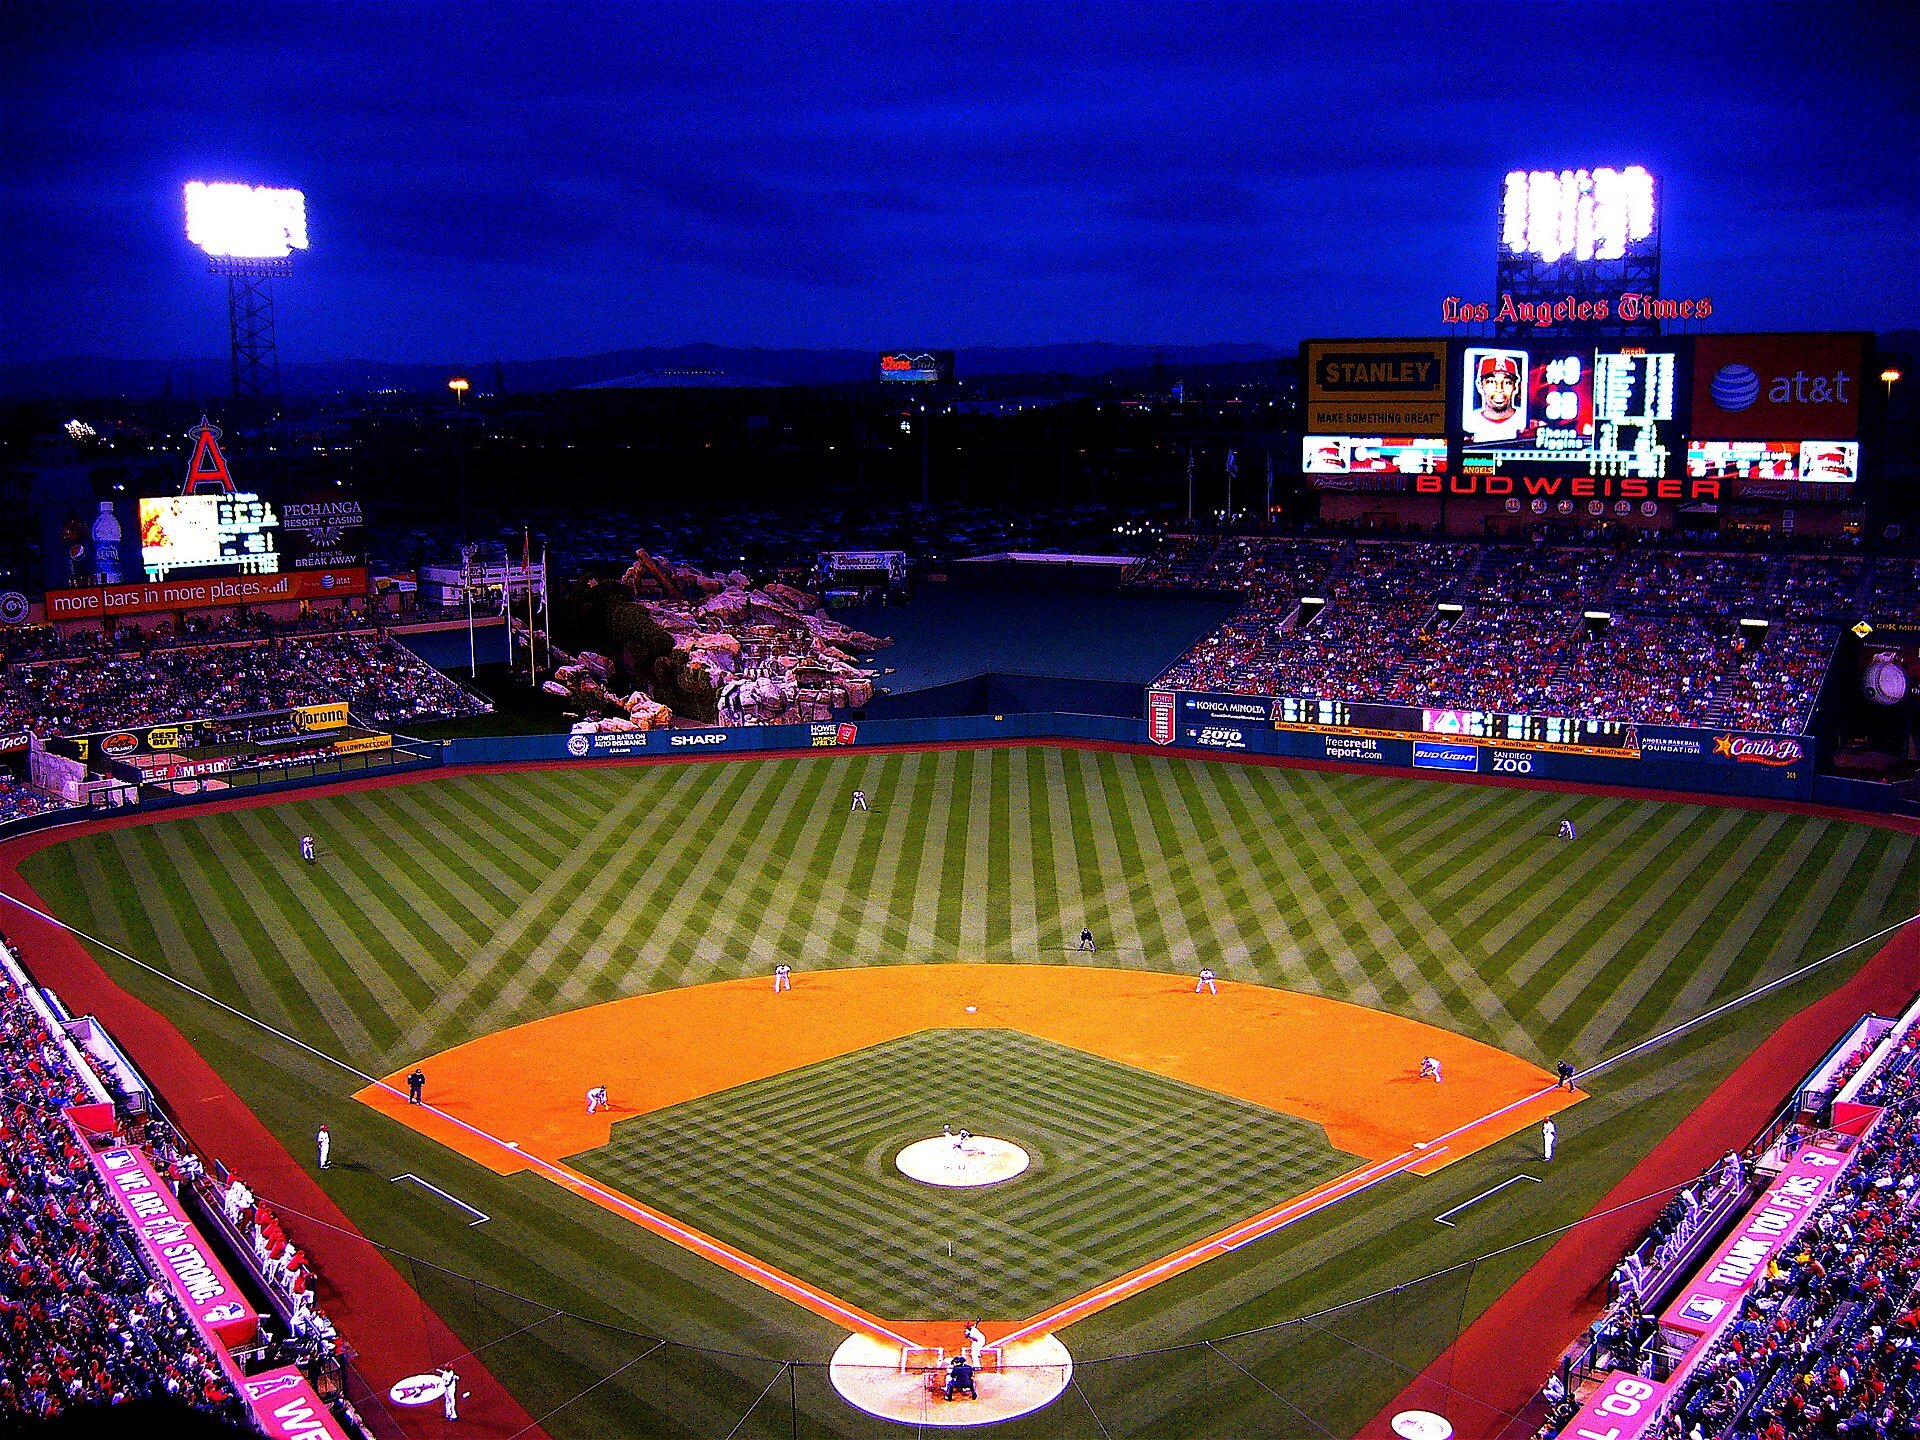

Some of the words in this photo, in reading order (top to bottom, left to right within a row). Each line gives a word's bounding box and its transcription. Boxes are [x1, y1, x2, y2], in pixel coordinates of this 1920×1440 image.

[1442, 296, 1489, 323] Los
[1494, 294, 1609, 327] Angeles
[1618, 292, 1713, 321] Times
[882, 356, 911, 370] Coors
[1326, 363, 1431, 383] STANLEY
[1769, 371, 1850, 403] at&t
[1317, 413, 1343, 423] MAKE
[1346, 413, 1401, 424] SOMETHING
[1416, 476, 1720, 498] BUDWEISER
[284, 502, 361, 516] PECHANGA
[284, 518, 320, 527] RESORT
[329, 516, 363, 524] CASINO
[296, 558, 327, 566] BREAK
[330, 556, 356, 564] AWAY
[54, 593, 98, 610] more
[103, 591, 139, 606] bars
[144, 588, 158, 602] in
[164, 586, 205, 601] more
[210, 581, 260, 602] places
[1197, 701, 1228, 711] KONICA
[1230, 704, 1265, 714] MINOLTA
[291, 708, 345, 733] Corona
[1276, 723, 1308, 731] AutoTrader
[1201, 729, 1242, 741] 2010
[1320, 726, 1353, 734] AutoTrader
[1364, 729, 1397, 737] AutoTrader
[0, 735, 28, 750] TACO
[671, 734, 727, 746] SHARP
[1325, 736, 1377, 749] freecredit
[1408, 733, 1443, 741] AutoTrader
[1454, 737, 1489, 745] AutoTrader
[1500, 741, 1537, 749] AutoTrader
[1549, 744, 1585, 753] AutoTrader
[1642, 744, 1700, 754] FOUNDATION
[1731, 738, 1775, 755] Carl's
[1776, 741, 1802, 759] Jr.
[1326, 747, 1383, 760] report.com
[1441, 752, 1476, 761] LIGHT
[1509, 752, 1532, 760] DIEGO
[1595, 748, 1632, 756] AutoTrader
[1493, 758, 1532, 773] ZOO
[114, 1168, 152, 1192] WE
[126, 1191, 169, 1219] ARE
[141, 1215, 192, 1245] FAN
[1706, 1234, 1775, 1288] THANK
[1746, 1206, 1796, 1237] YOU
